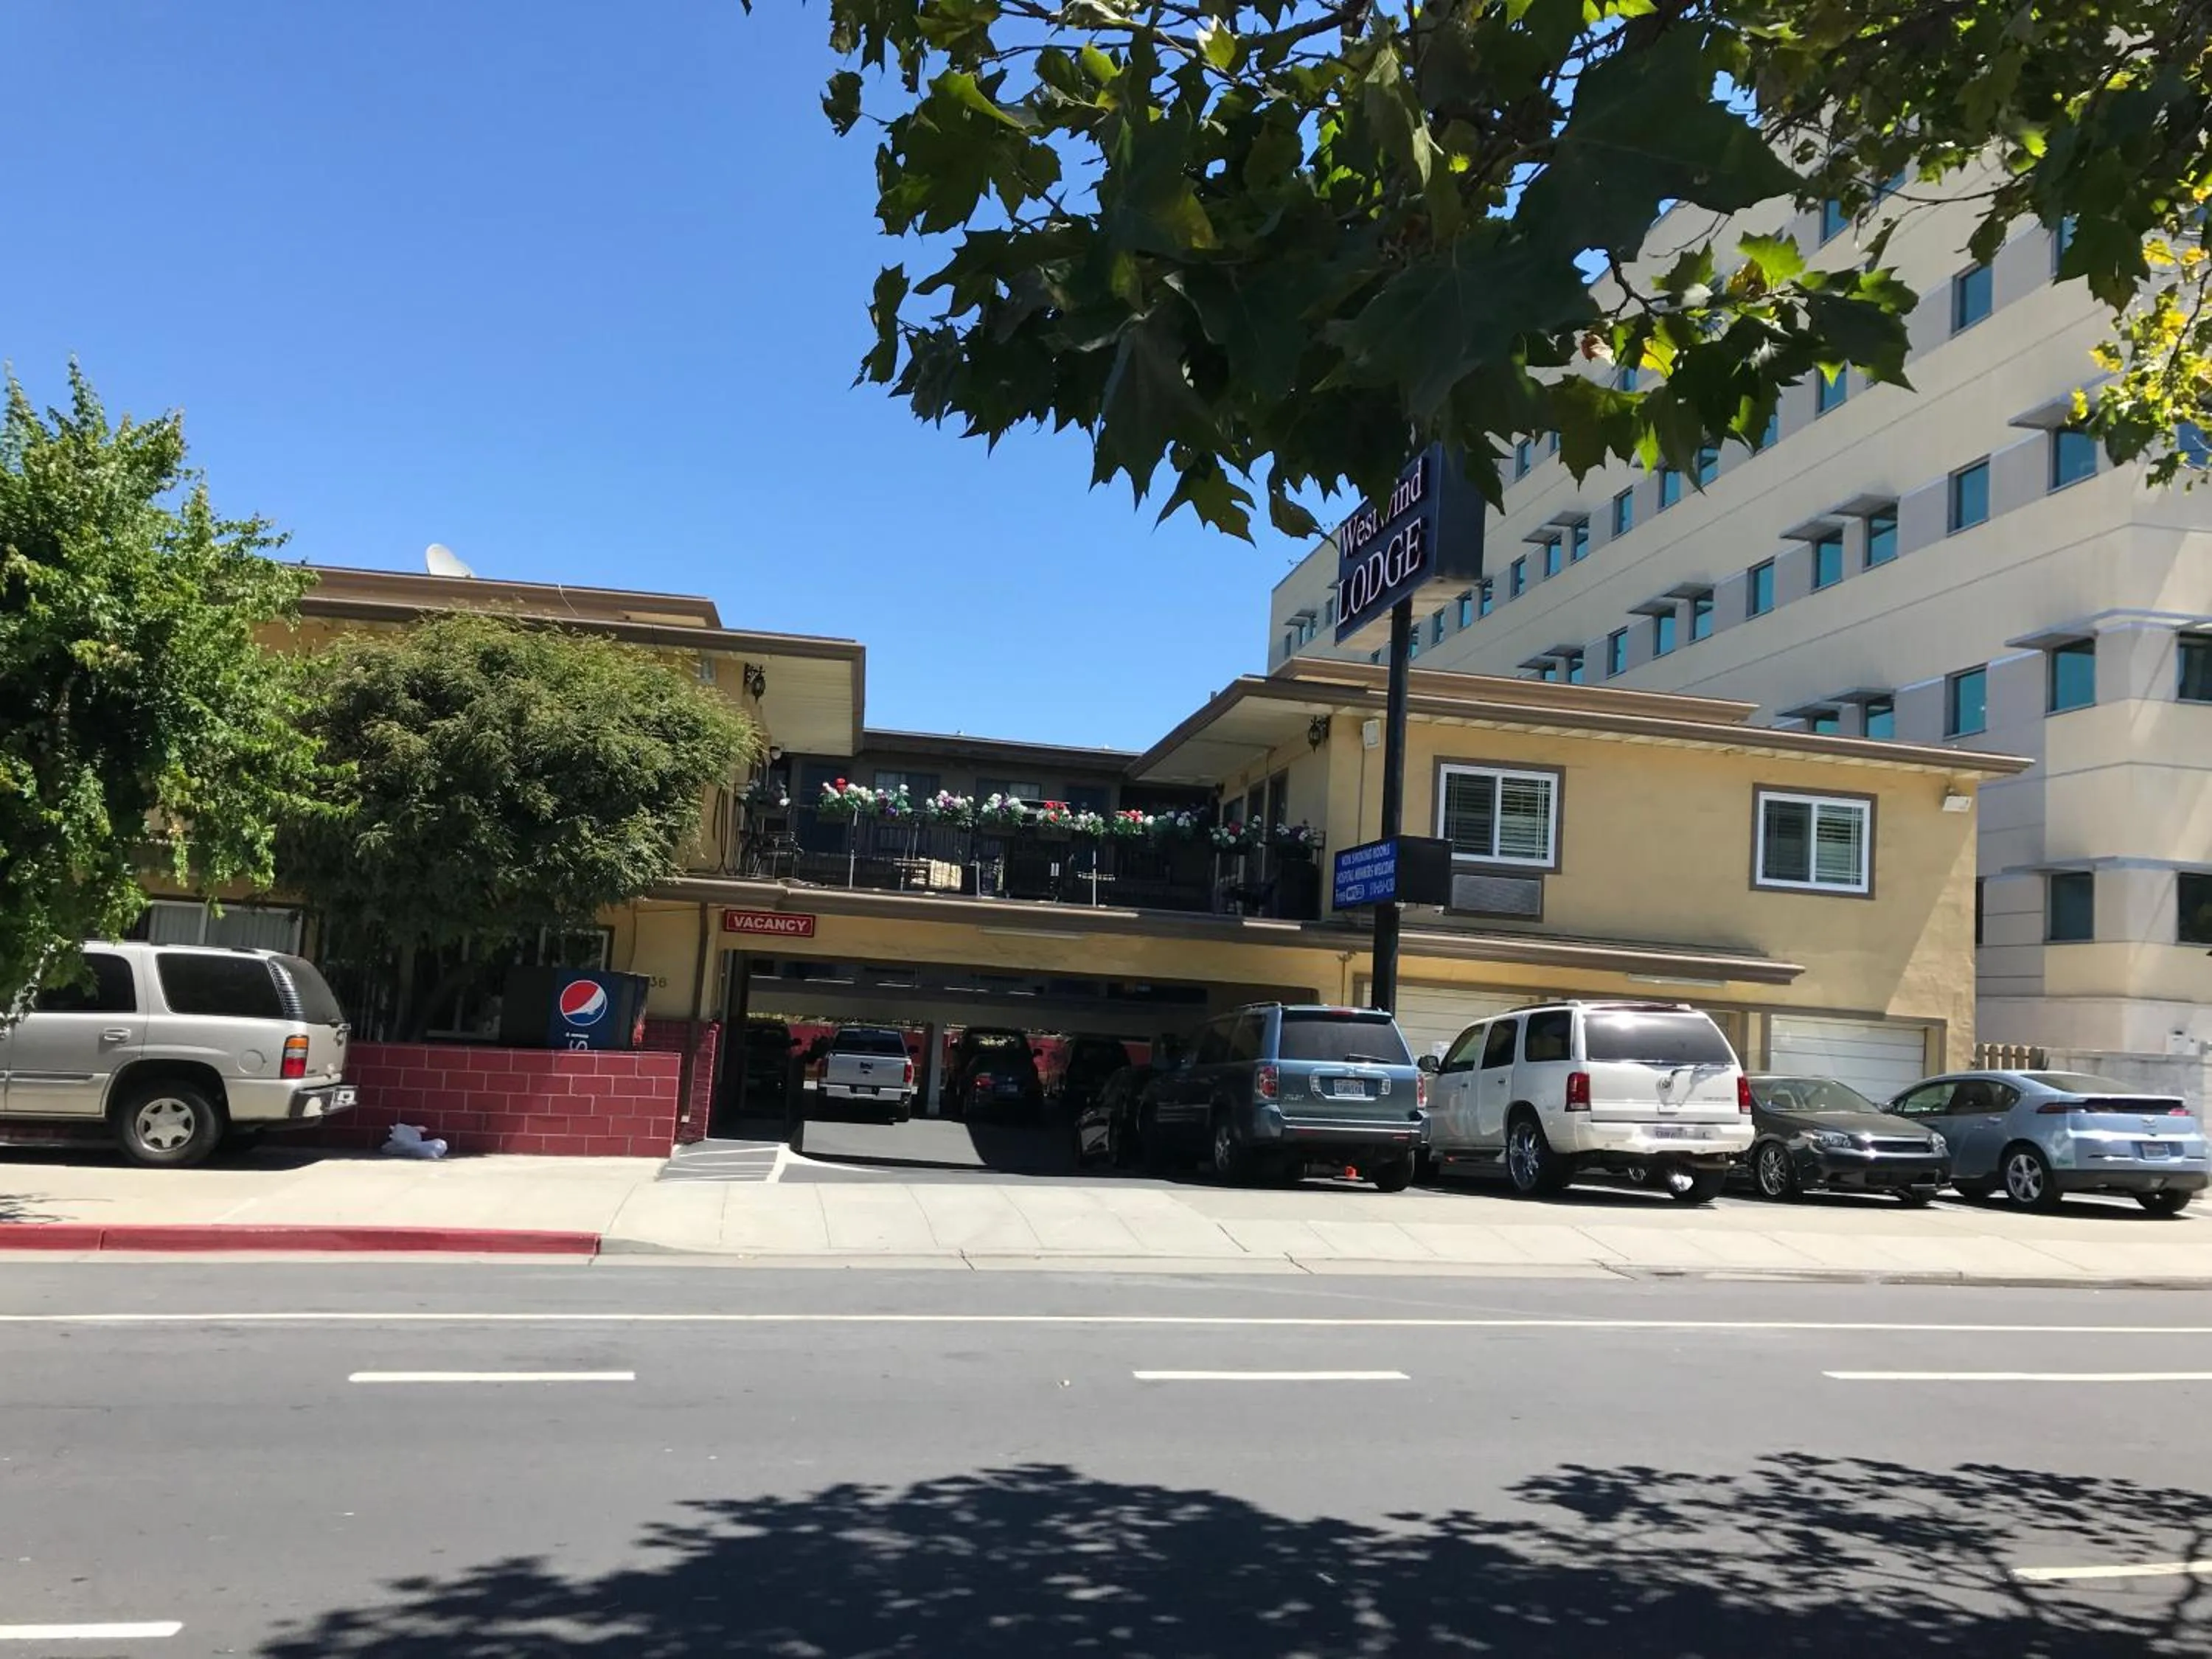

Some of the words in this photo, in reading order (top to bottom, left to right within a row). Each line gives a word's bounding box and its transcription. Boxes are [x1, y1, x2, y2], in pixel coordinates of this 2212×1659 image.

[1341, 457, 1423, 557] Westind
[1337, 516, 1422, 627] LODGE
[734, 916, 807, 931] VACANCY
